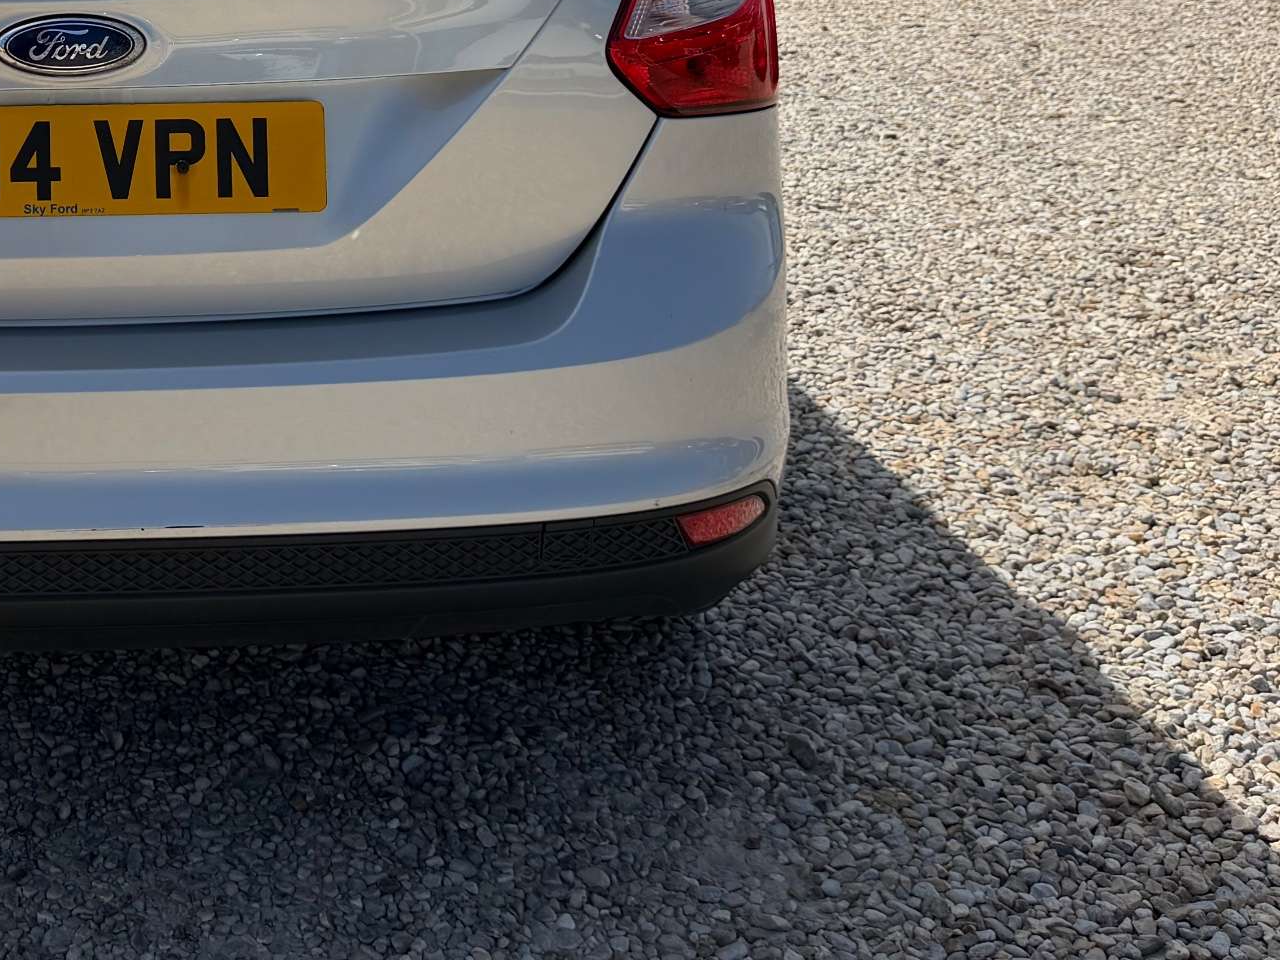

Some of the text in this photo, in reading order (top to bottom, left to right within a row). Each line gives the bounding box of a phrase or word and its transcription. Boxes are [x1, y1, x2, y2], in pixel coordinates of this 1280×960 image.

[29, 28, 110, 61] Ford
[93, 117, 270, 201] VPN
[23, 203, 46, 216] Sky
[50, 203, 78, 214] Ford
